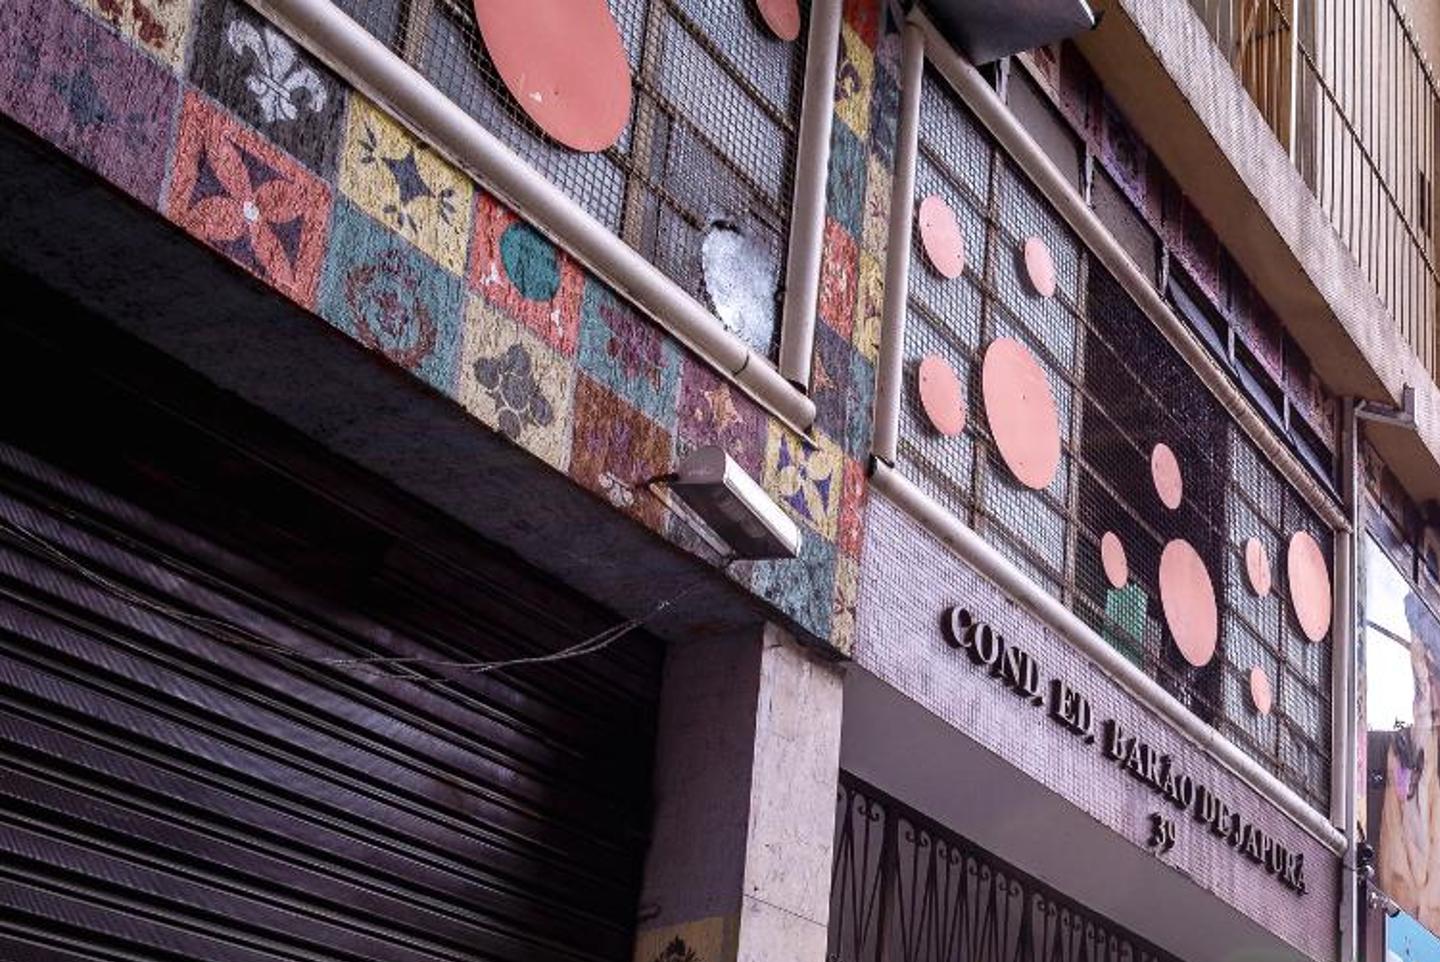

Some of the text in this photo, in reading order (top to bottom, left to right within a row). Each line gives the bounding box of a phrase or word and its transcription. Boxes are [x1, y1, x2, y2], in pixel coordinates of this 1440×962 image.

[942, 605, 1044, 706] COND.
[1049, 677, 1095, 745] ED.
[1196, 784, 1233, 840] DE
[1150, 810, 1177, 852] 39
